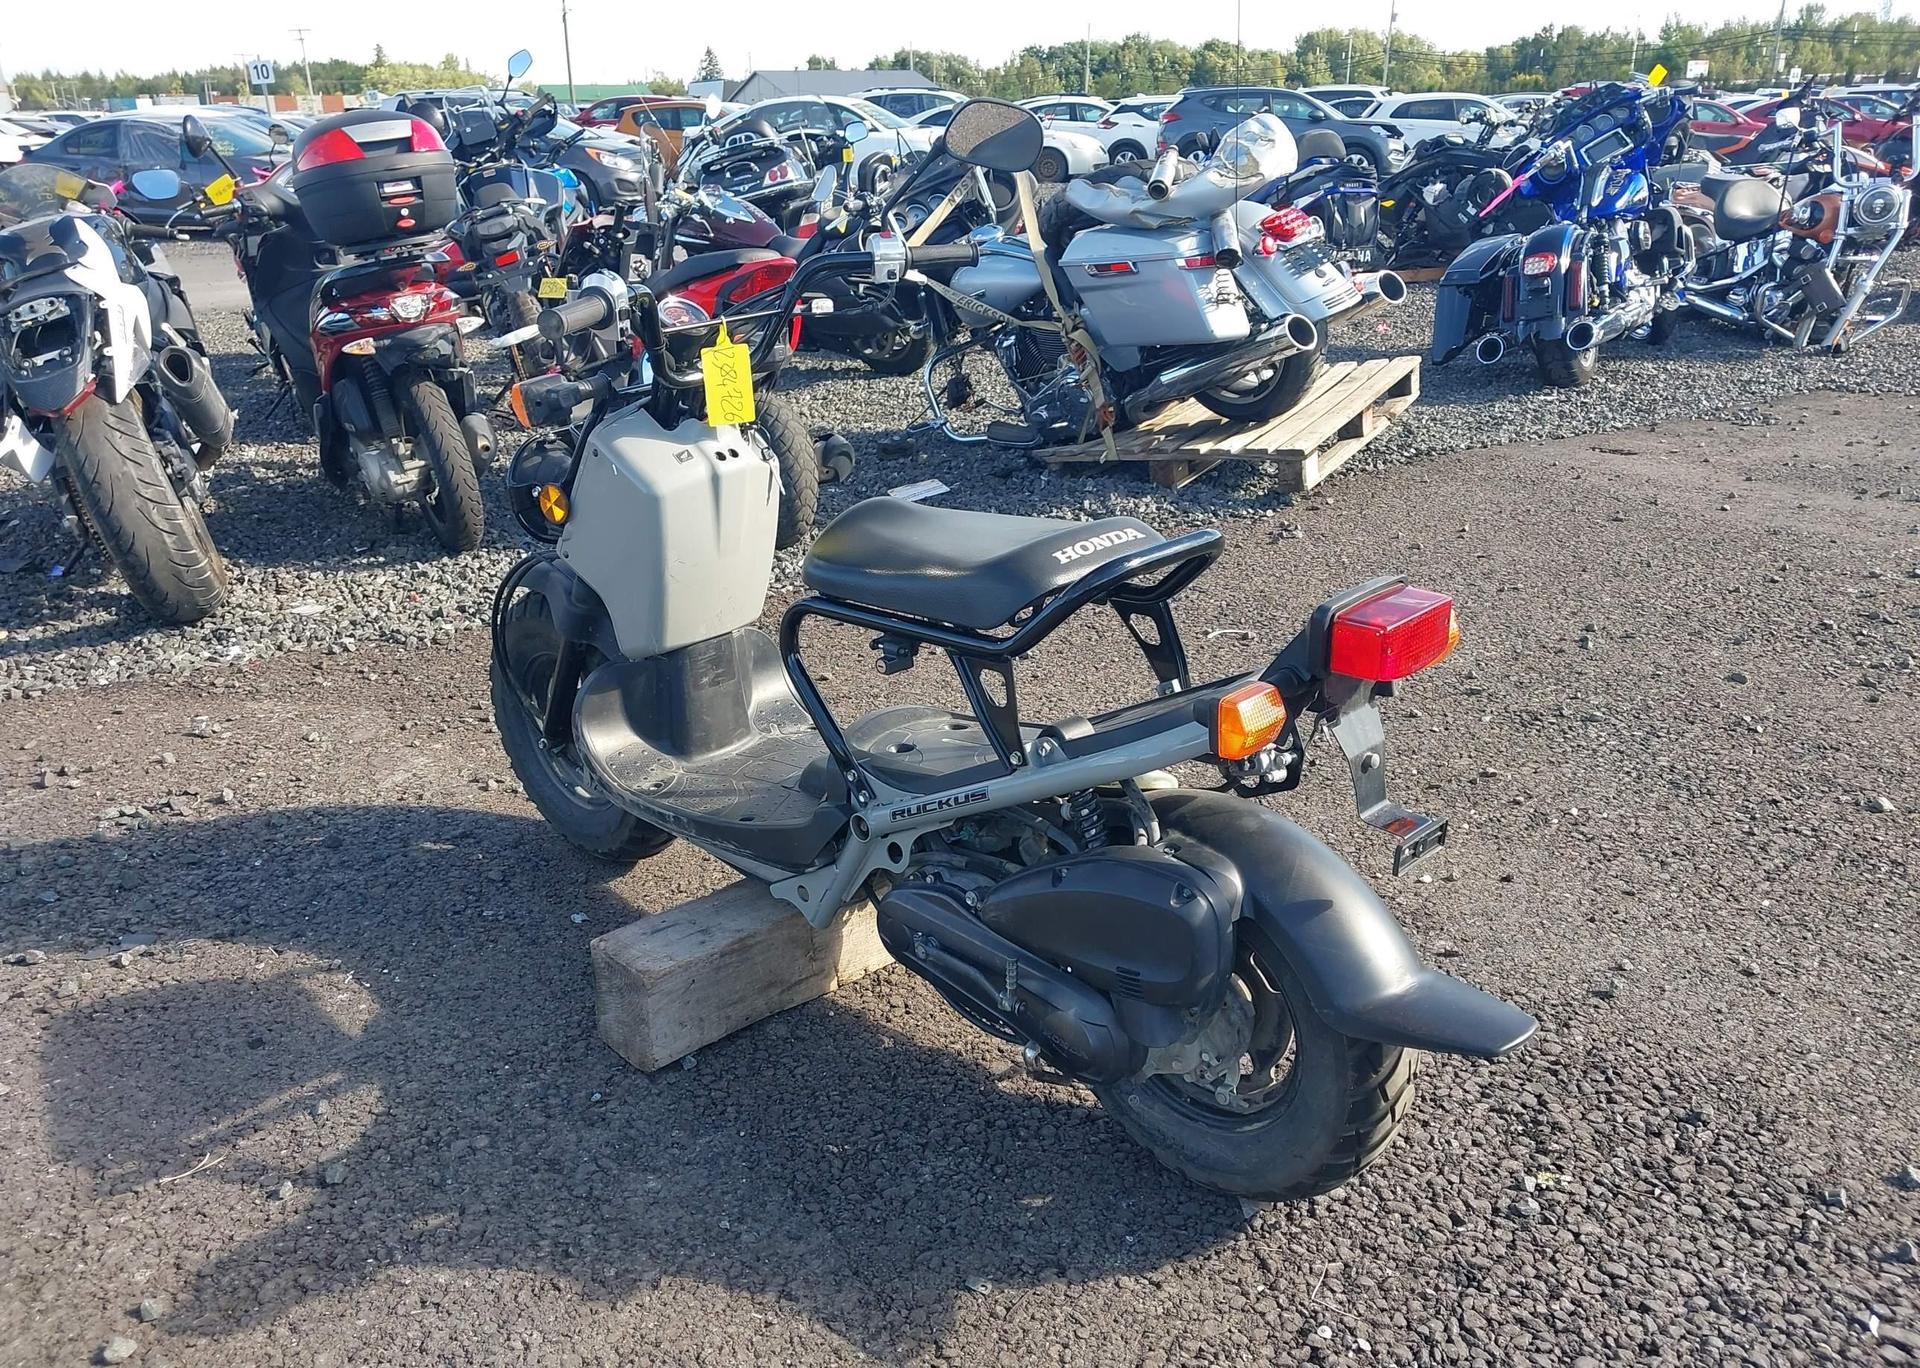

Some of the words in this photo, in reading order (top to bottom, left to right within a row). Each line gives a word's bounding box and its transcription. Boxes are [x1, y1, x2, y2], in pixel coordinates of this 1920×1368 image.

[252, 64, 270, 80] 10
[1051, 527, 1147, 565] HONDA
[891, 788, 988, 821] RUCKUS
